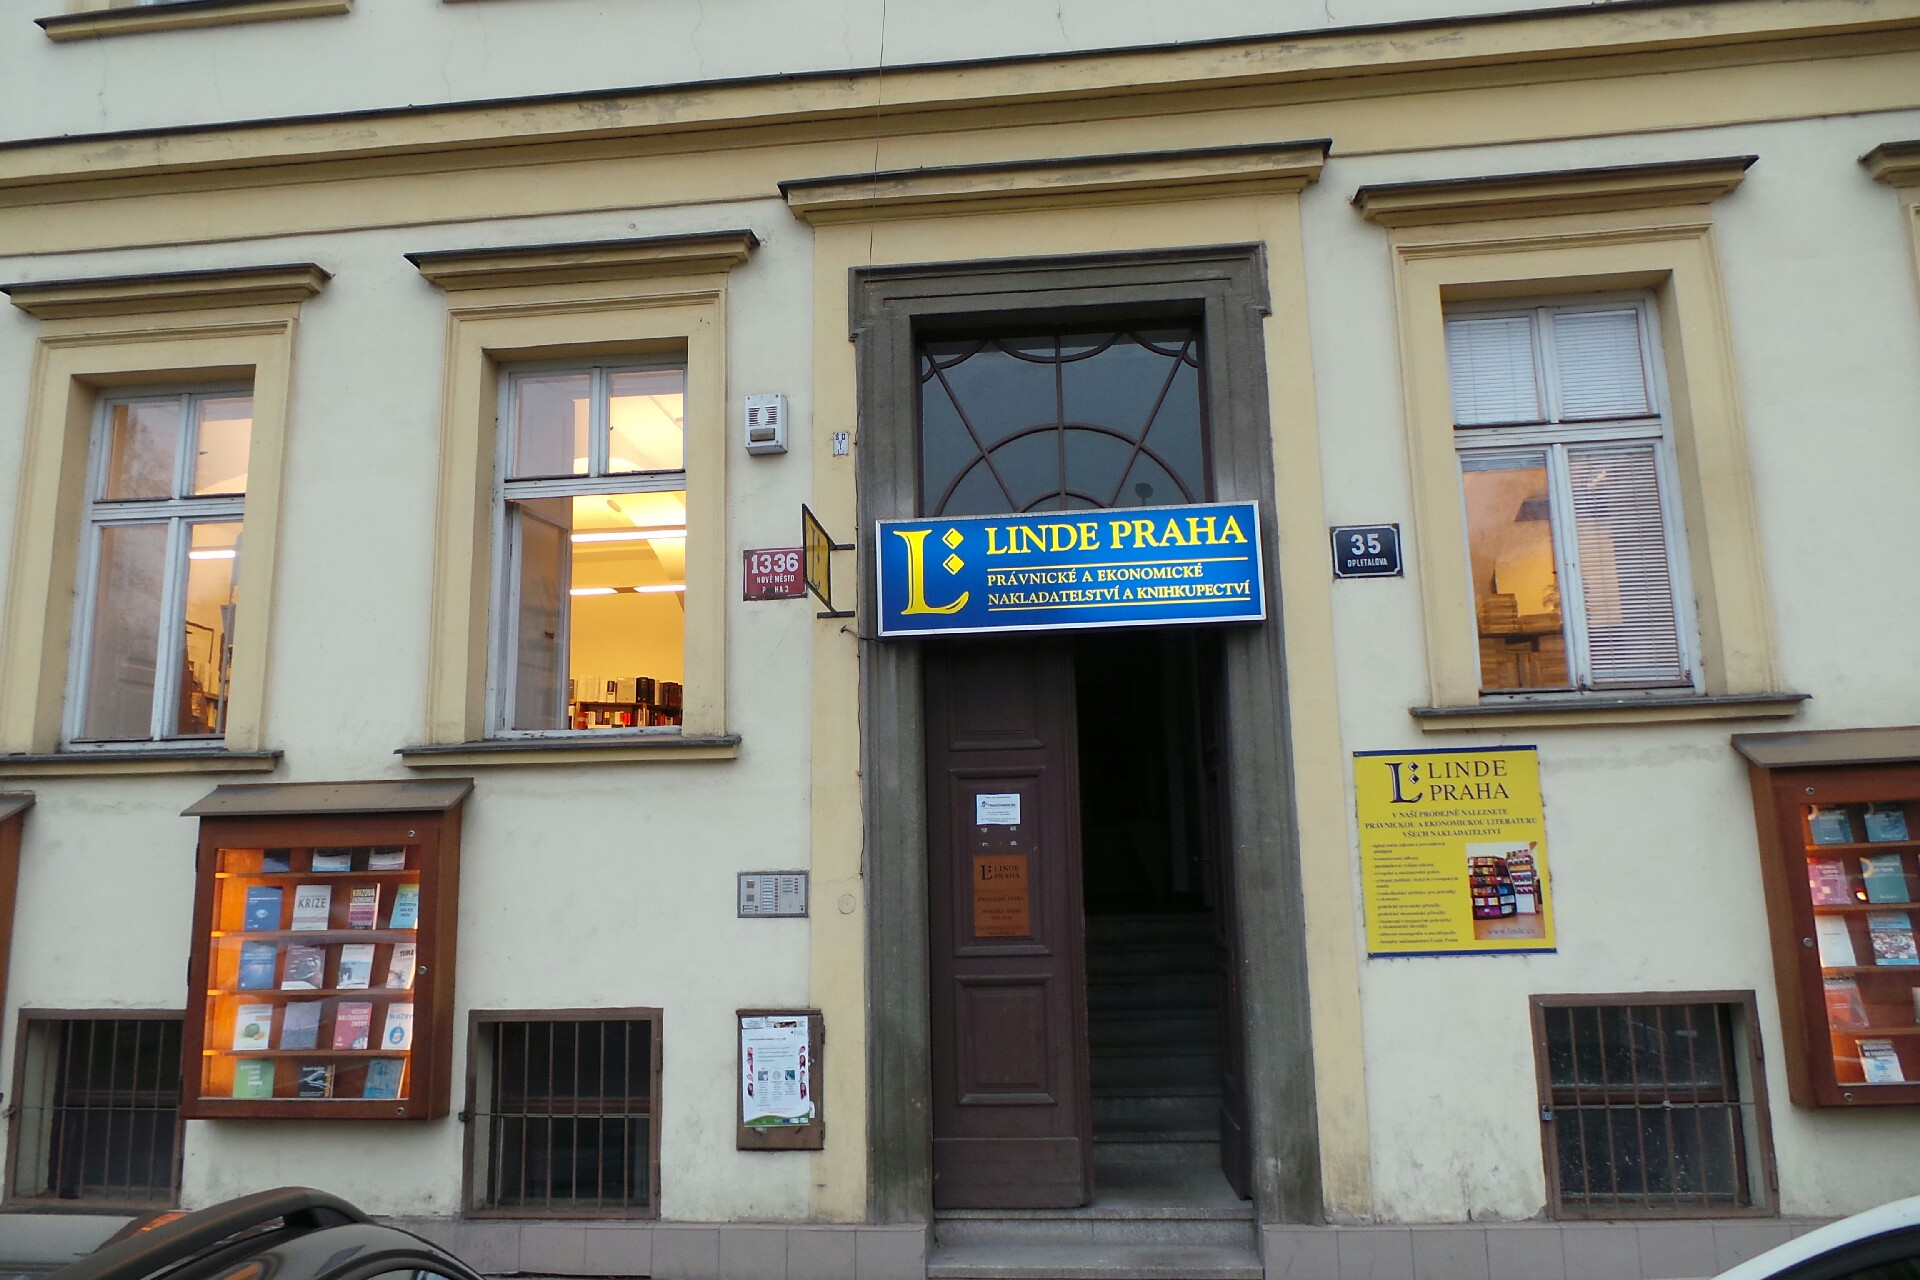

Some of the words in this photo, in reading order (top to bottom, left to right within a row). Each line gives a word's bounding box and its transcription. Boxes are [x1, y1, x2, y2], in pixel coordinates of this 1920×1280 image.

[985, 522, 1100, 555] LINDE
[1109, 515, 1248, 549] PRAHA
[1350, 533, 1381, 555] 35
[751, 552, 799, 574] 1336
[1347, 557, 1388, 568] OPLETALOVA
[756, 574, 773, 584] NOVÉ
[774, 573, 795, 584] MĚSTO
[987, 568, 1077, 587] PRÁVNICKÉ
[1082, 570, 1093, 582] A
[1097, 562, 1203, 582] EKONOMICKÉ
[762, 585, 783, 594] PHA
[988, 585, 1120, 606] NAKLADATELSTVÍ
[1122, 587, 1134, 600] A
[1137, 580, 1250, 599] KNIHKUPECTVÍ
[1428, 760, 1507, 779] LINDE
[1430, 782, 1510, 801] PRAHA
[1399, 810, 1418, 818] NAŠÍ
[1419, 809, 1460, 817] PRODEJNĚ
[1461, 808, 1508, 816] NALEZNETE
[1365, 820, 1416, 829] PRÁVNICKOU
[1424, 818, 1484, 827] EKONOMICKOU
[1486, 816, 1537, 826] LITERATURU
[1402, 830, 1429, 838] VŠECH
[1430, 828, 1502, 837] NAKLADATELSTVÍ
[298, 898, 327, 909] KRIZE
